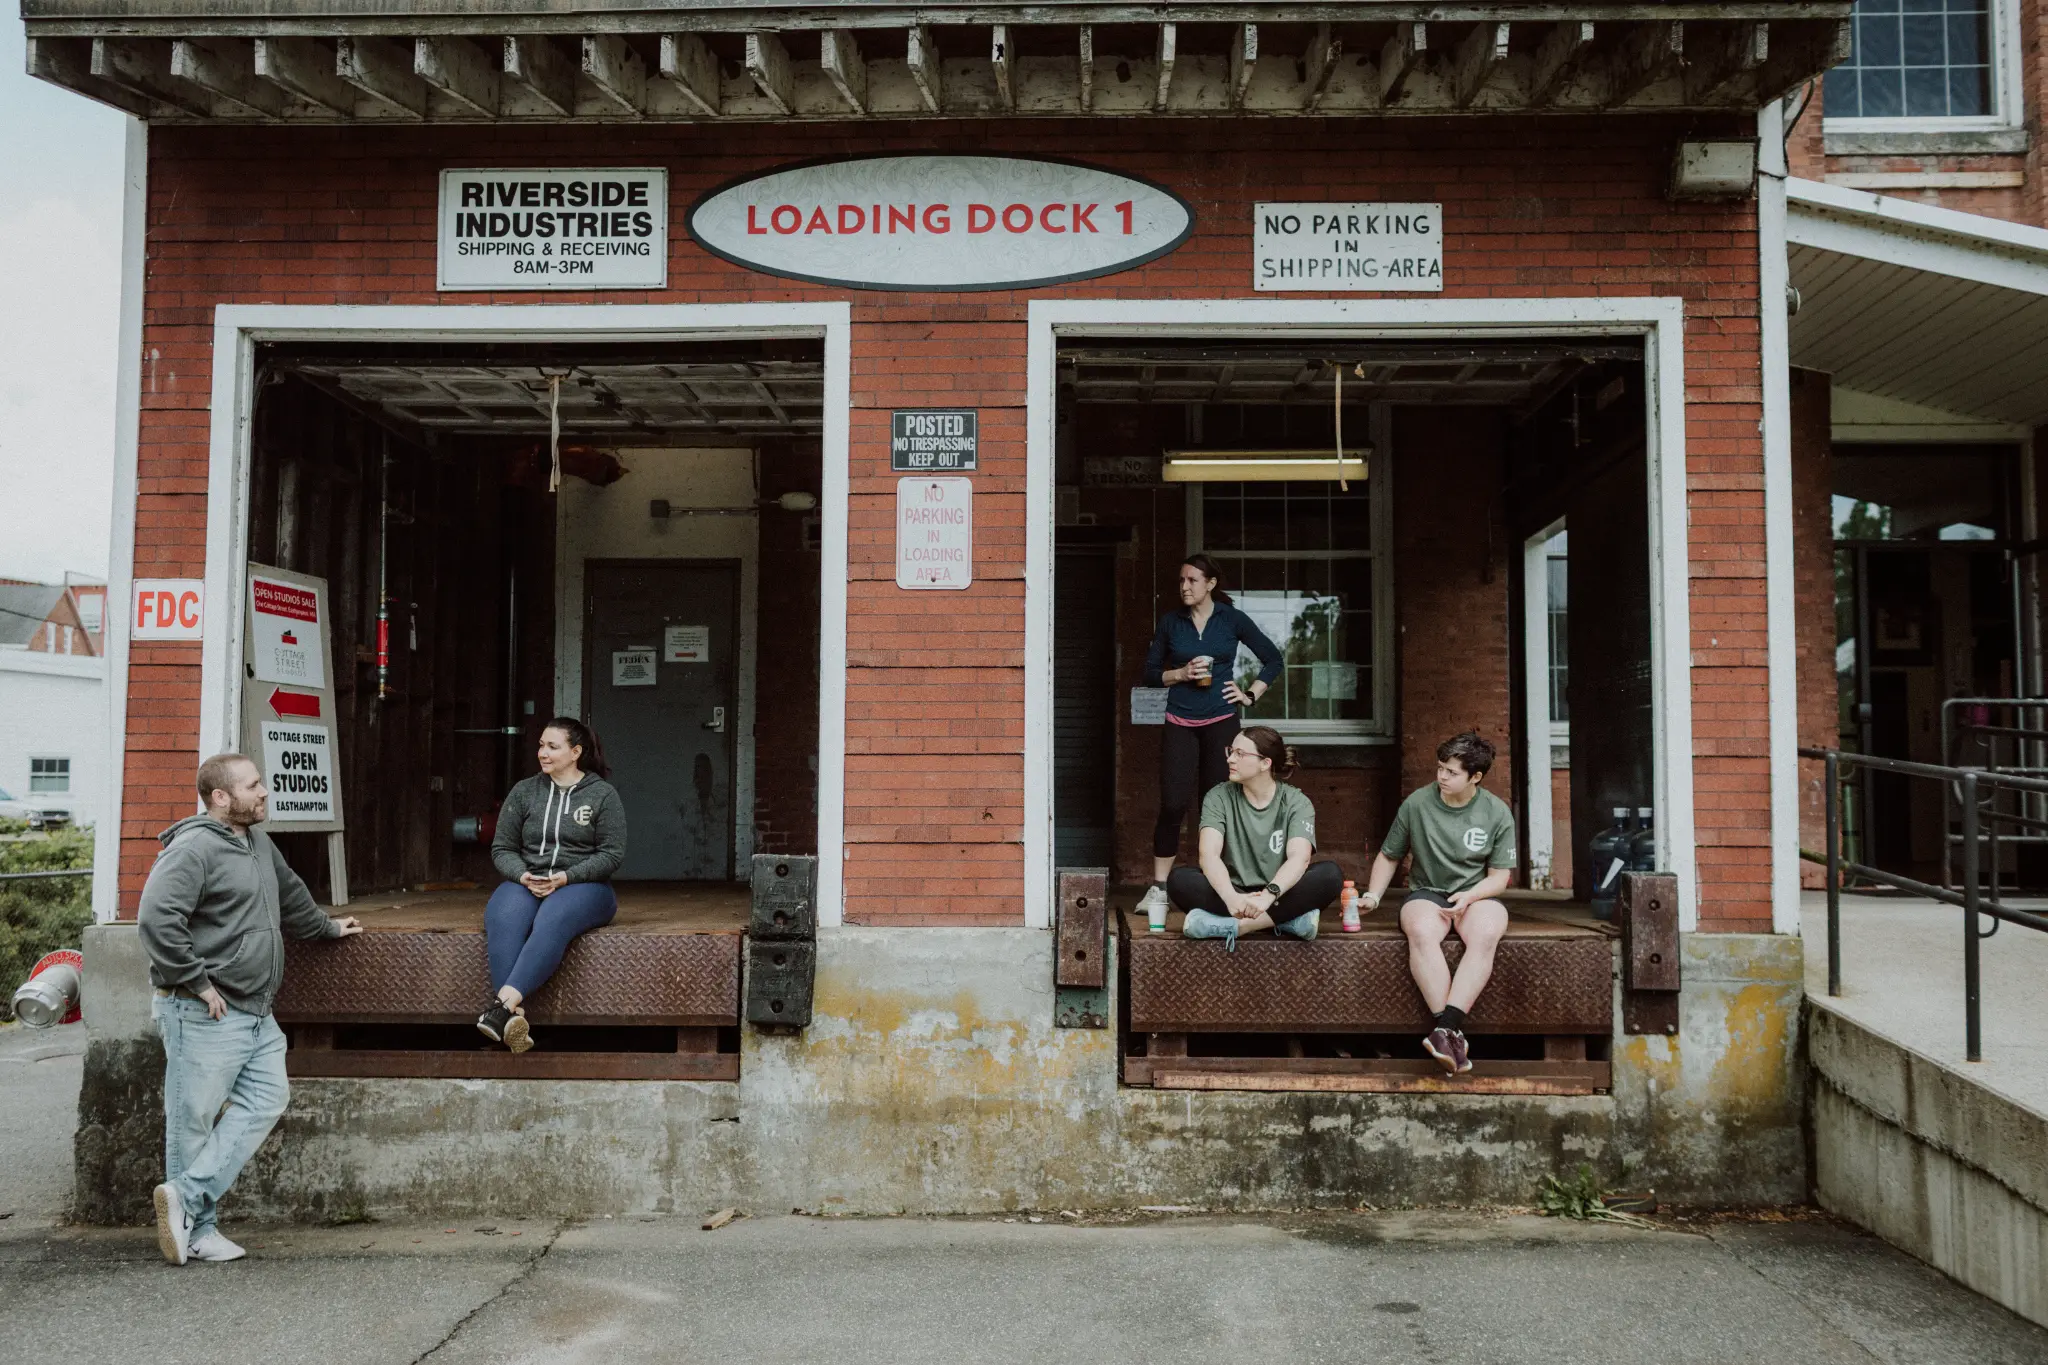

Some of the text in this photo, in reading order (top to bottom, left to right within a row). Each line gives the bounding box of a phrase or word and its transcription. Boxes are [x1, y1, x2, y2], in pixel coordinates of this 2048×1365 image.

[461, 181, 649, 208] RIVERSIDE
[455, 211, 653, 238] INDUSTRIES
[746, 201, 1133, 236] LOADING DOCK 1
[1264, 215, 1430, 235] NO PARKING
[457, 242, 650, 256] SHIPPING & RECEIVING
[1335, 240, 1358, 253] IN
[513, 260, 594, 274] 8AM-3PM
[905, 415, 964, 436] POSTED
[894, 437, 974, 451] NO TRESPASSING
[908, 453, 960, 467] KEEP OUT
[1124, 460, 1142, 471] NO
[924, 485, 945, 503] NO
[905, 507, 964, 525] PARKING
[927, 529, 940, 543] IN
[904, 547, 964, 562] LOADING
[915, 567, 952, 581] AREA
[255, 587, 316, 608] OPEN STUDIOS SALE
[137, 590, 199, 629] FDC
[275, 657, 305, 669] STREET
[268, 730, 325, 745] COTTAGE STREET
[281, 750, 318, 771] OPEN
[273, 773, 328, 794] STUDIOS
[276, 801, 328, 812] EASTHAMPTON
